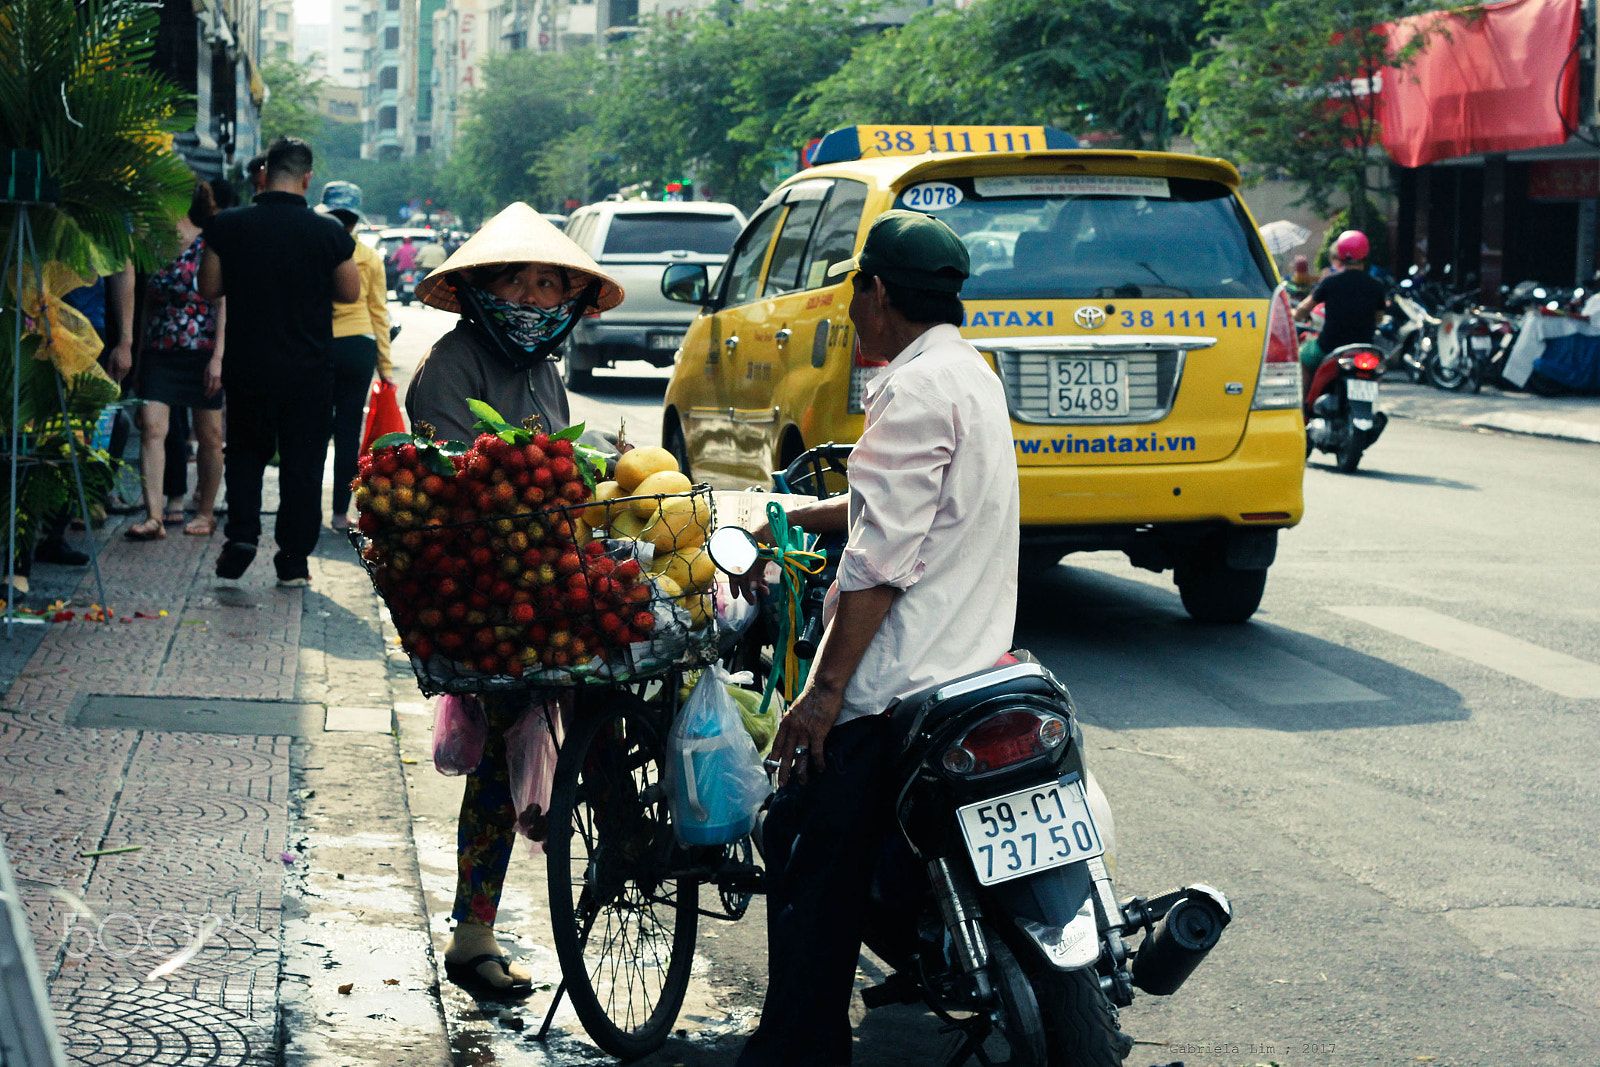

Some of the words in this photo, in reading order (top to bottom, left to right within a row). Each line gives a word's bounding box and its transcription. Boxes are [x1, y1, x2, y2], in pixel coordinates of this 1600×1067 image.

[874, 130, 915, 152] 38
[924, 131, 976, 152] 111
[985, 132, 1032, 152] 111
[910, 187, 956, 205] 2078
[1120, 310, 1154, 328] 38
[1164, 310, 1206, 328] 111
[1216, 310, 1257, 329] 111
[1057, 361, 1118, 386] 52LD
[1058, 387, 1119, 411] 5489
[1013, 432, 1196, 454] w.vinataxi.vn
[976, 788, 1067, 837] 59-C1
[978, 820, 1093, 877] 737.50
